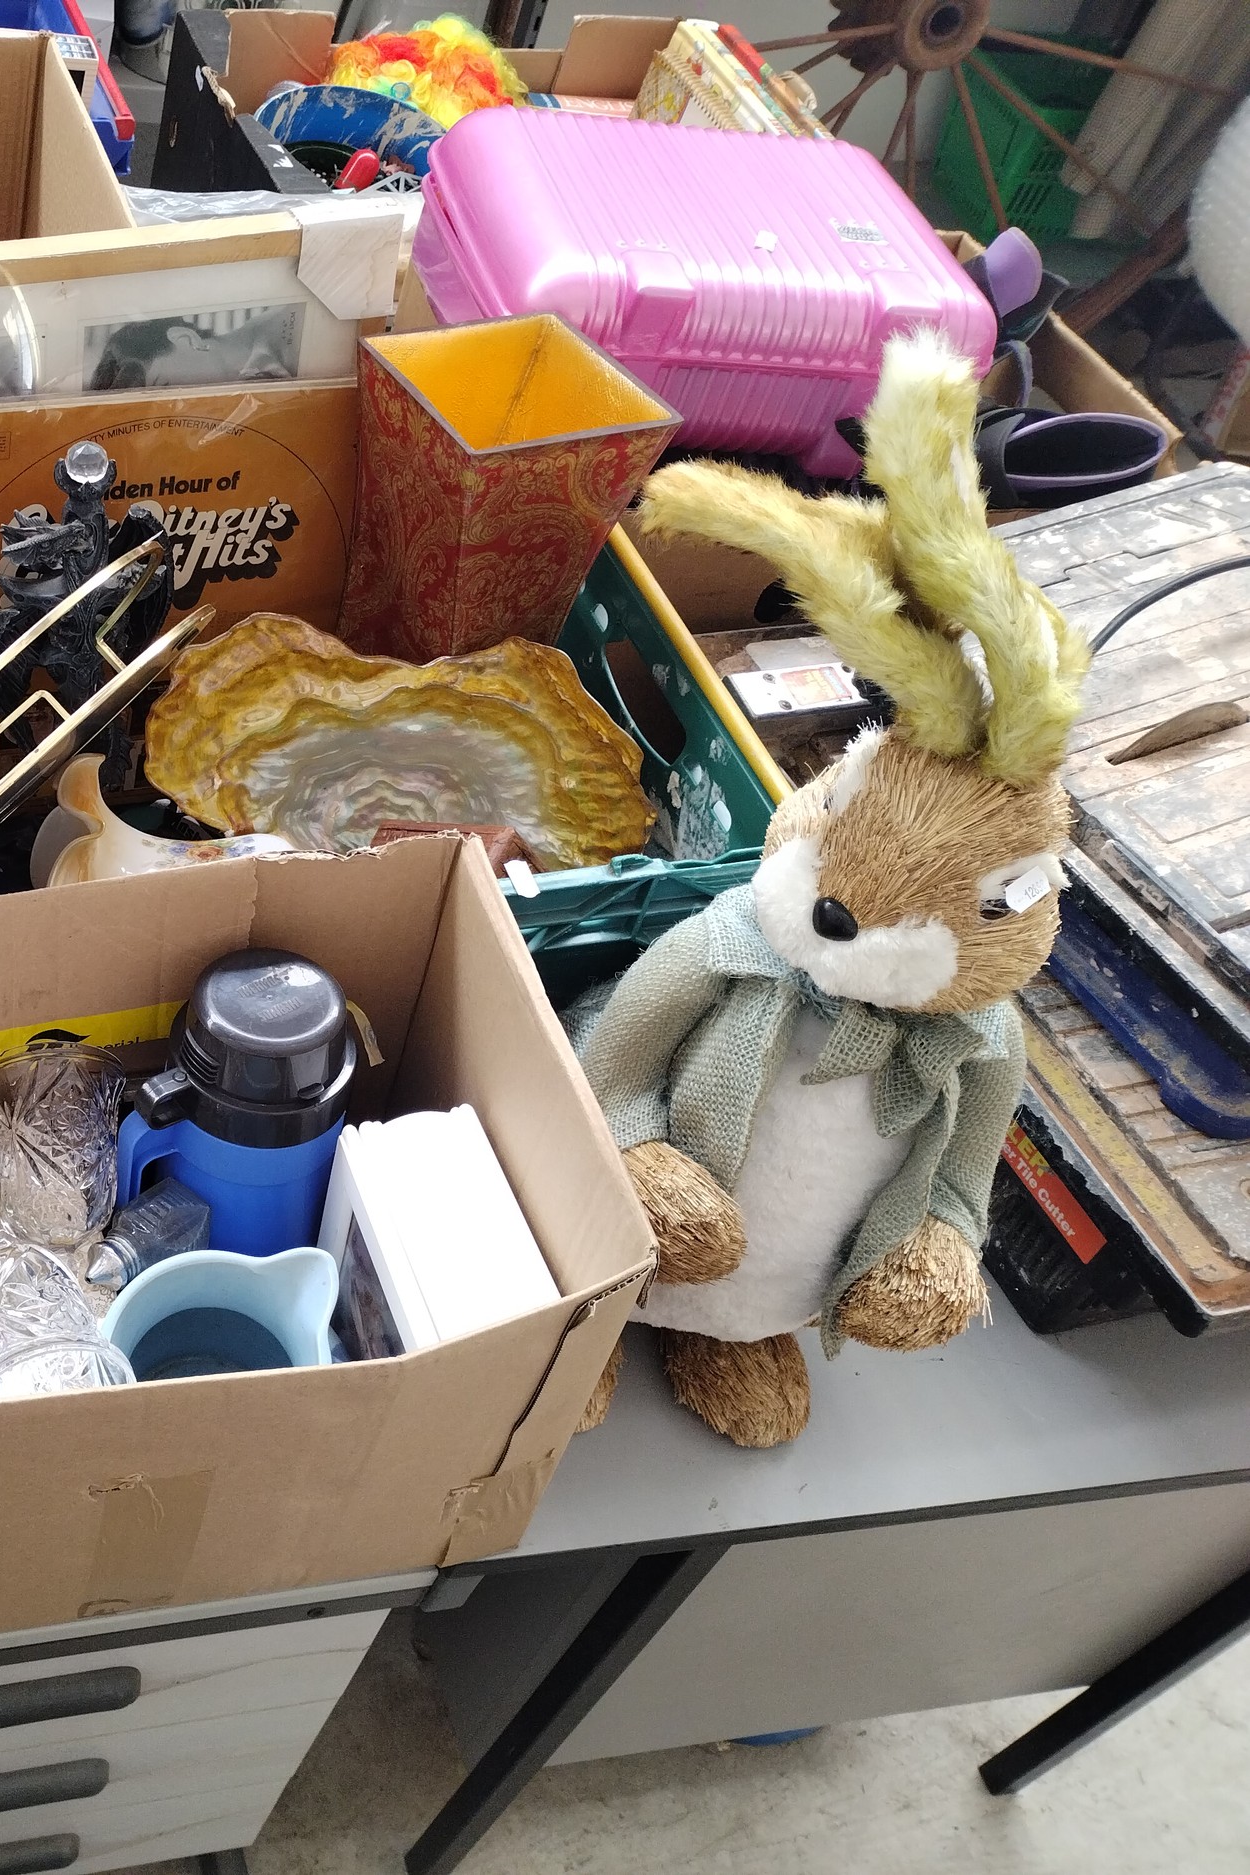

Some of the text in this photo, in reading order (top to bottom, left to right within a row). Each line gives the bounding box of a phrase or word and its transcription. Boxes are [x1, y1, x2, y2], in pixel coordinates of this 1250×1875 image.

[563, 97, 635, 111] ENGLIS
[107, 422, 151, 439] MINUTES
[153, 419, 166, 429] OF
[167, 418, 245, 438] ENTERTAINMENT
[158, 475, 213, 496] Hour
[216, 470, 241, 491] of
[174, 527, 274, 590] Hits
[1006, 1121, 1050, 1177] LER
[1016, 1157, 1038, 1189] Tile
[1038, 1187, 1076, 1236] Cutter
